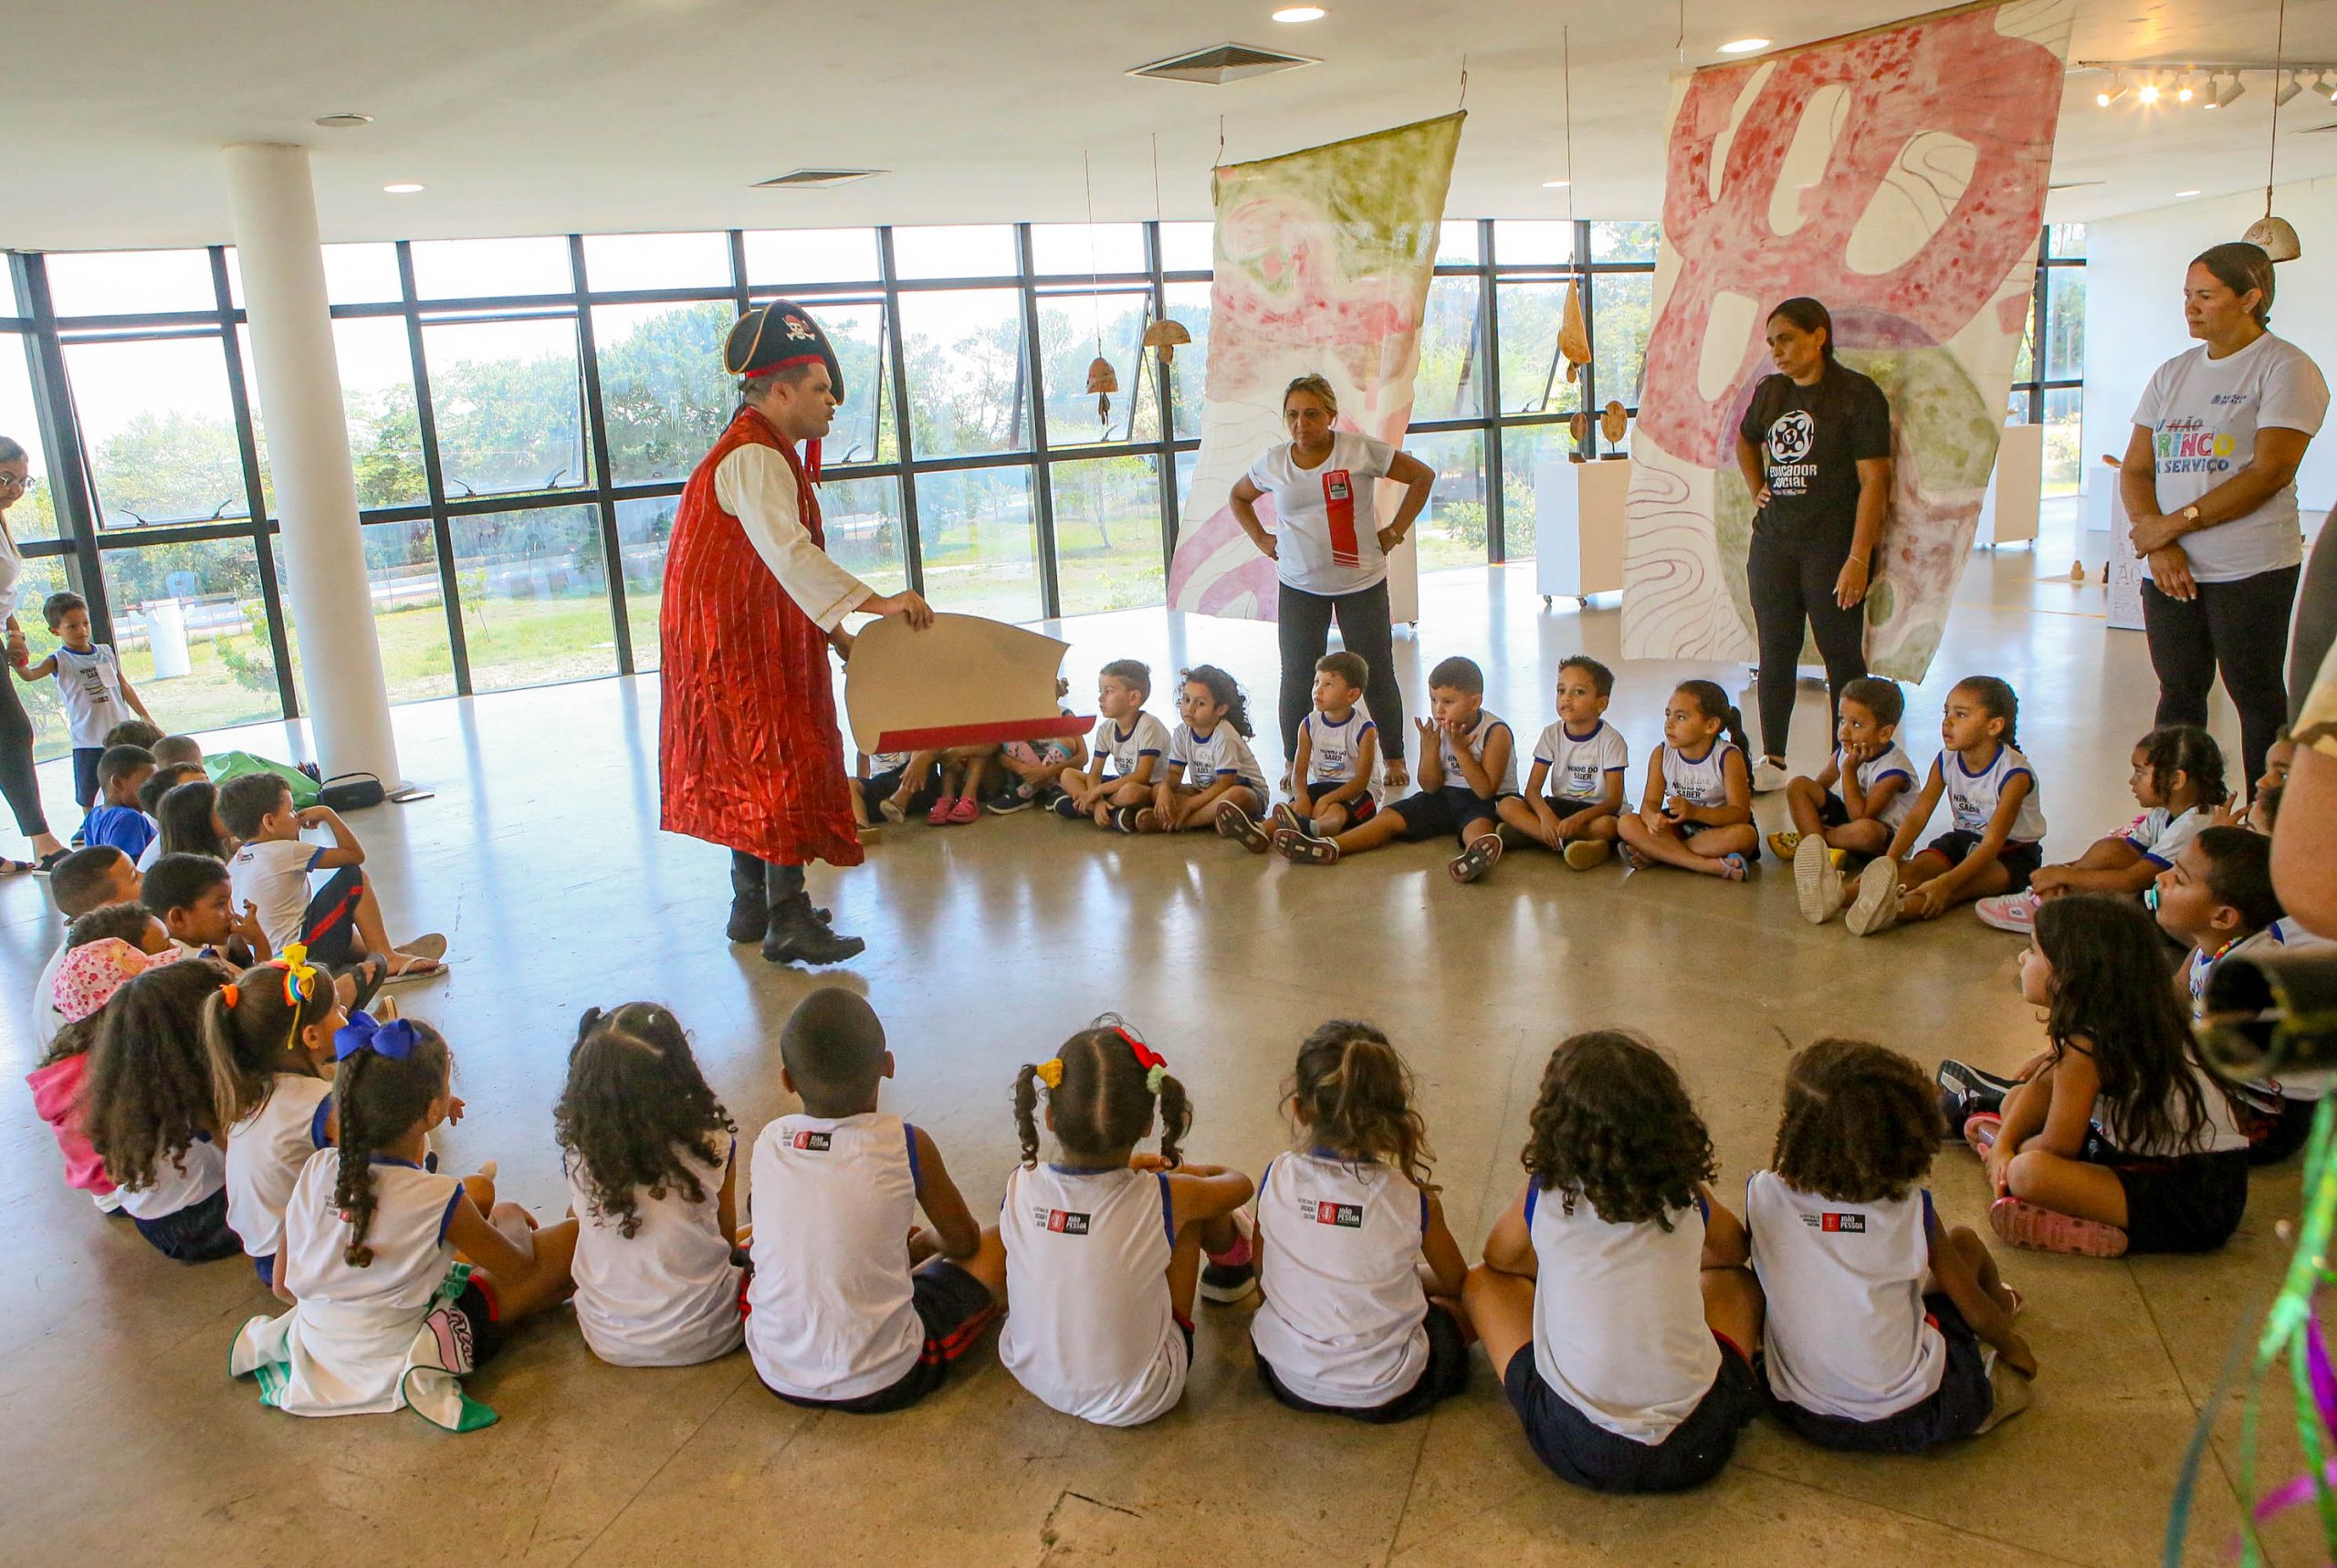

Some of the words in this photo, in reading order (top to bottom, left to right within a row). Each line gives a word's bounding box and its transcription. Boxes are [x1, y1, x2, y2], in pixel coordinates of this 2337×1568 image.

[2167, 416, 2204, 432] NÃO
[2154, 433, 2236, 457] RINCO
[2164, 458, 2229, 474] SERVIÇO
[1325, 753, 1343, 762] SABER
[1676, 789, 1702, 800] SABER
[1336, 1212, 1360, 1222] PESSOA
